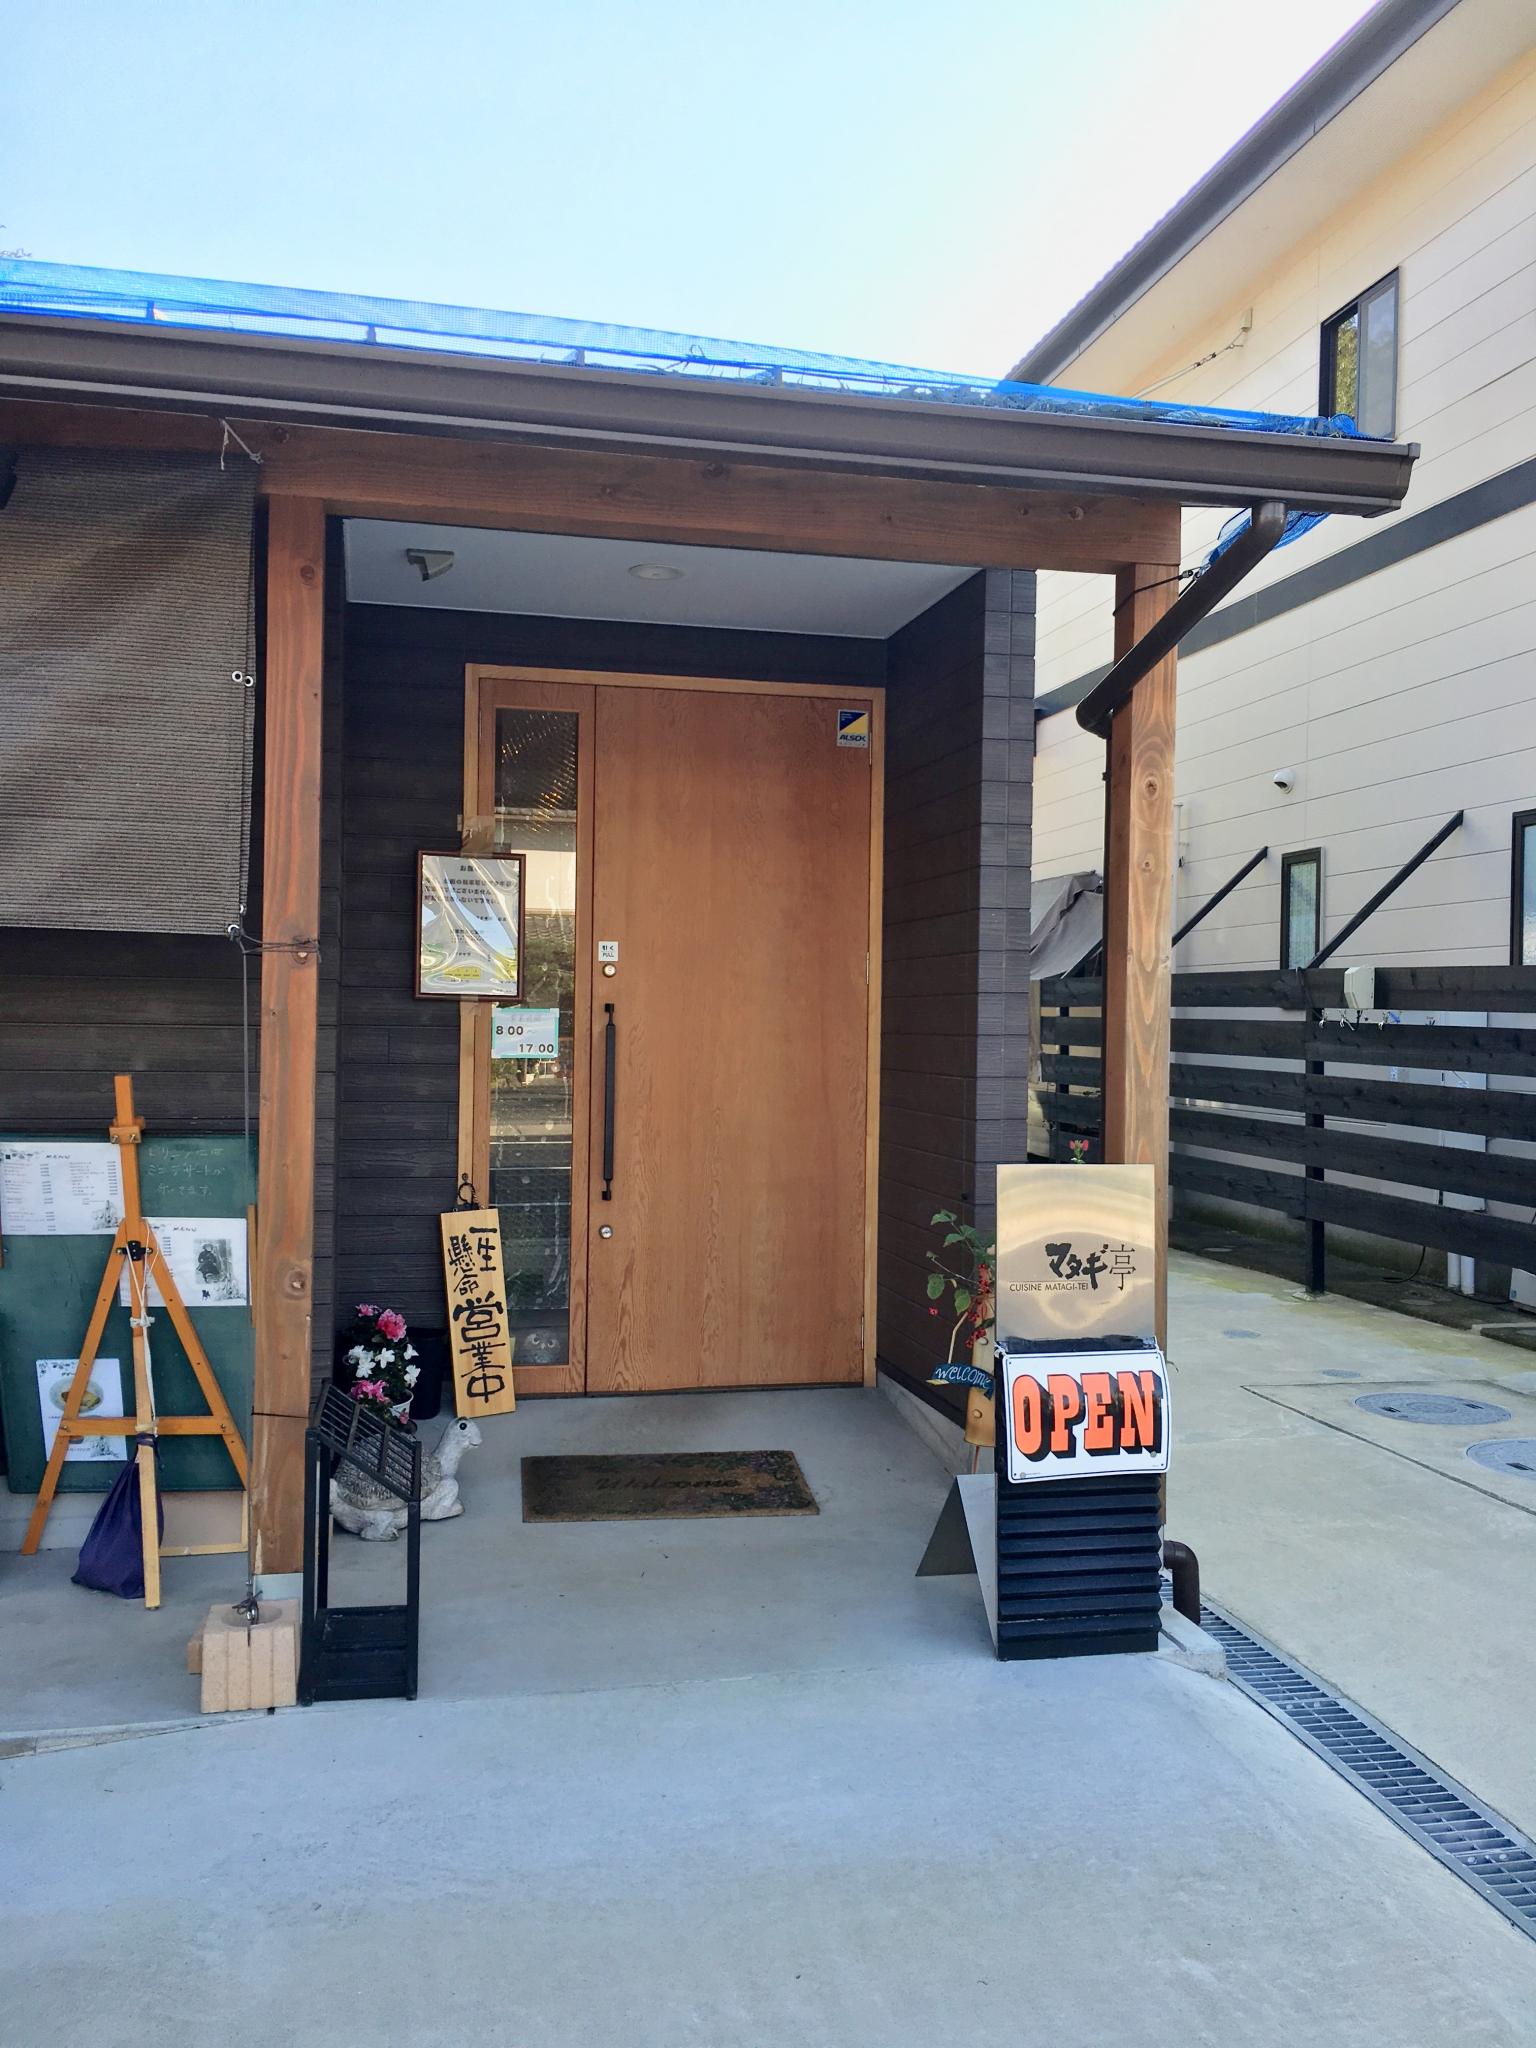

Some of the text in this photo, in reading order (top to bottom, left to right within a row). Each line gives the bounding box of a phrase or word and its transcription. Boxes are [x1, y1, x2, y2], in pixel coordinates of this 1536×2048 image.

[839, 734, 866, 742] ALSOK
[1045, 1242, 1137, 1291] マタギ亭
[1009, 1281, 1089, 1292] CUISINE MATAGI-TEI
[1012, 1370, 1162, 1462] OPEN
